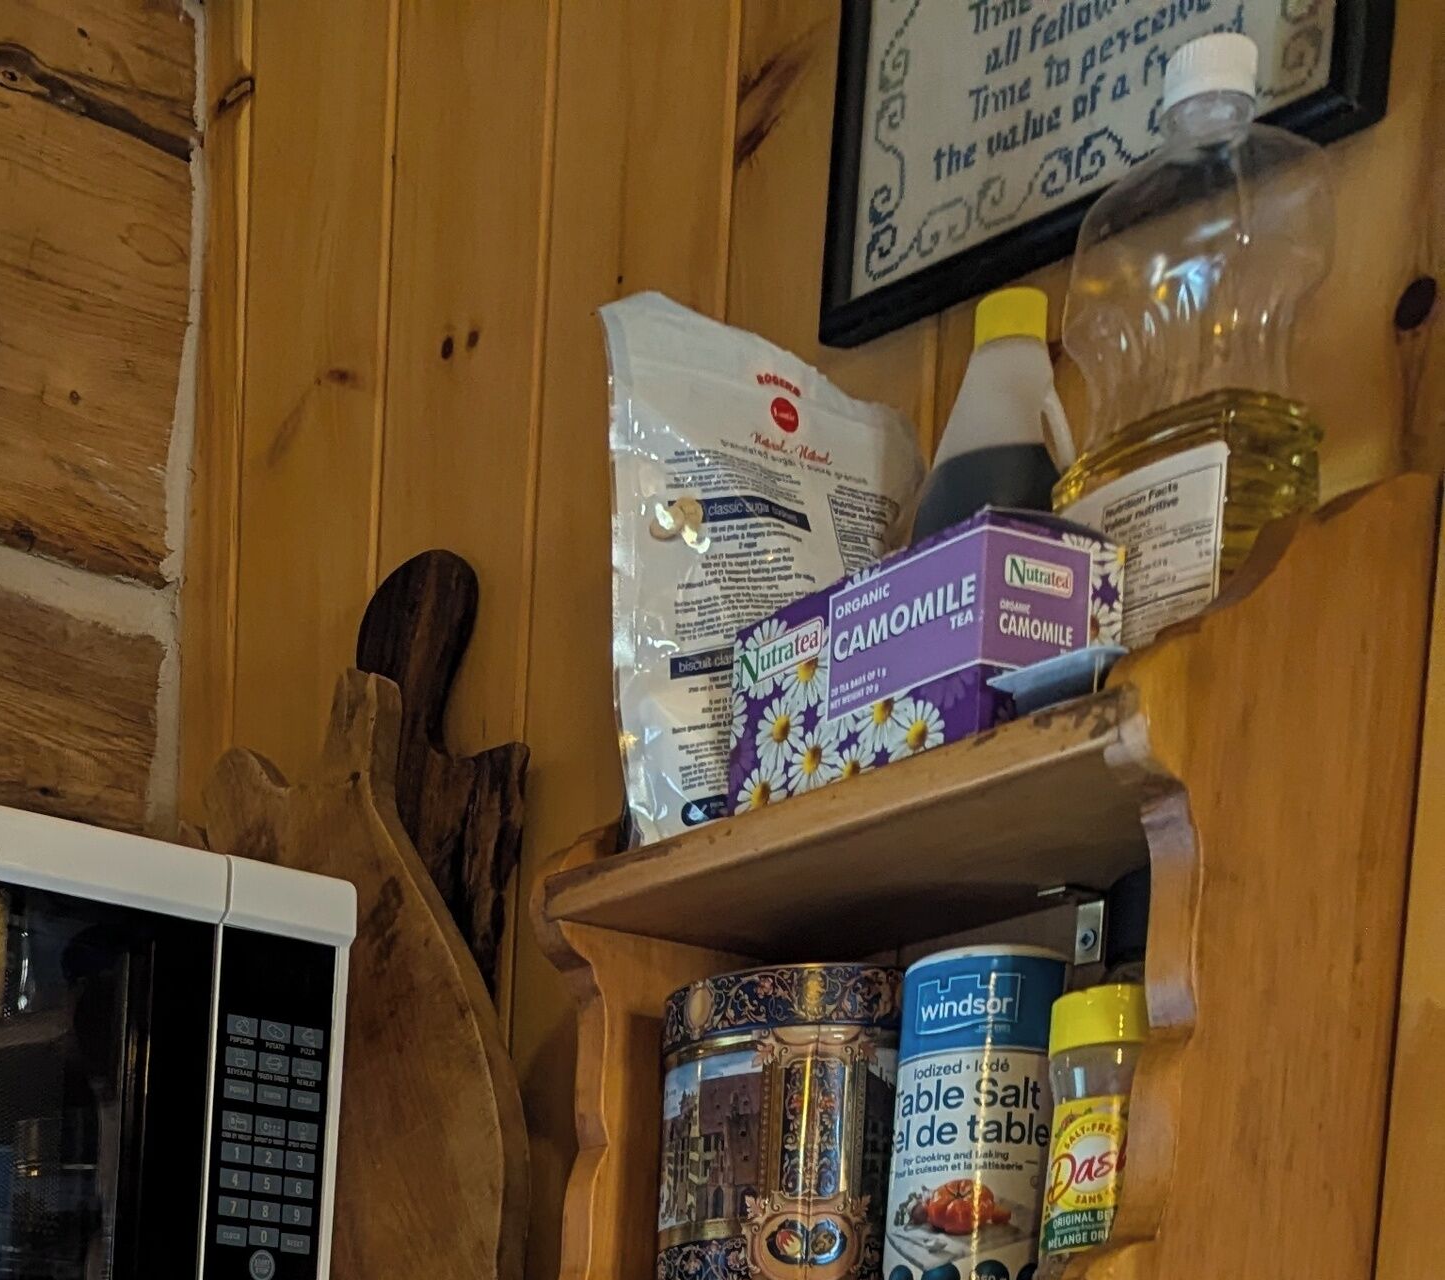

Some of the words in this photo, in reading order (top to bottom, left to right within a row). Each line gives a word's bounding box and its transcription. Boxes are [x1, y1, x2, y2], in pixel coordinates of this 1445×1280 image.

[986, 27, 1022, 75] all
[969, 77, 1031, 122] Time
[1044, 55, 1070, 88] to
[933, 143, 977, 181] the
[987, 106, 1062, 156] value
[1073, 72, 1106, 124] of
[1111, 73, 1131, 101] a
[708, 502, 743, 516] classic
[835, 582, 891, 620] ORGANIC
[999, 598, 1031, 615] ORGANIC
[833, 573, 978, 662] CAMOMILE
[949, 609, 975, 631] TEA
[999, 611, 1074, 647] CAMOMILE
[678, 657, 714, 674] biscuit
[738, 628, 821, 691] Nutratea
[920, 992, 1014, 1022] windsor
[913, 1059, 962, 1080] Iodized
[973, 1076, 1041, 1111] Salt
[916, 1115, 959, 1147] de
[967, 1112, 1049, 1148] table
[234, 1147, 240, 1160] 1
[265, 1151, 272, 1165] 2
[297, 1155, 304, 1169] 3
[915, 1152, 950, 1165] Cooking
[953, 1150, 972, 1160] and
[951, 1161, 962, 1171] et
[963, 1160, 973, 1171] la
[231, 1173, 239, 1187] 4
[263, 1177, 270, 1190] 5
[295, 1181, 302, 1194] 6
[230, 1200, 237, 1214] 7
[1074, 1194, 1103, 1205] SANS
[262, 1205, 269, 1218] 8
[294, 1208, 301, 1222] 9
[1052, 1212, 1094, 1230] ORIGINAL
[260, 1229, 268, 1244] 0
